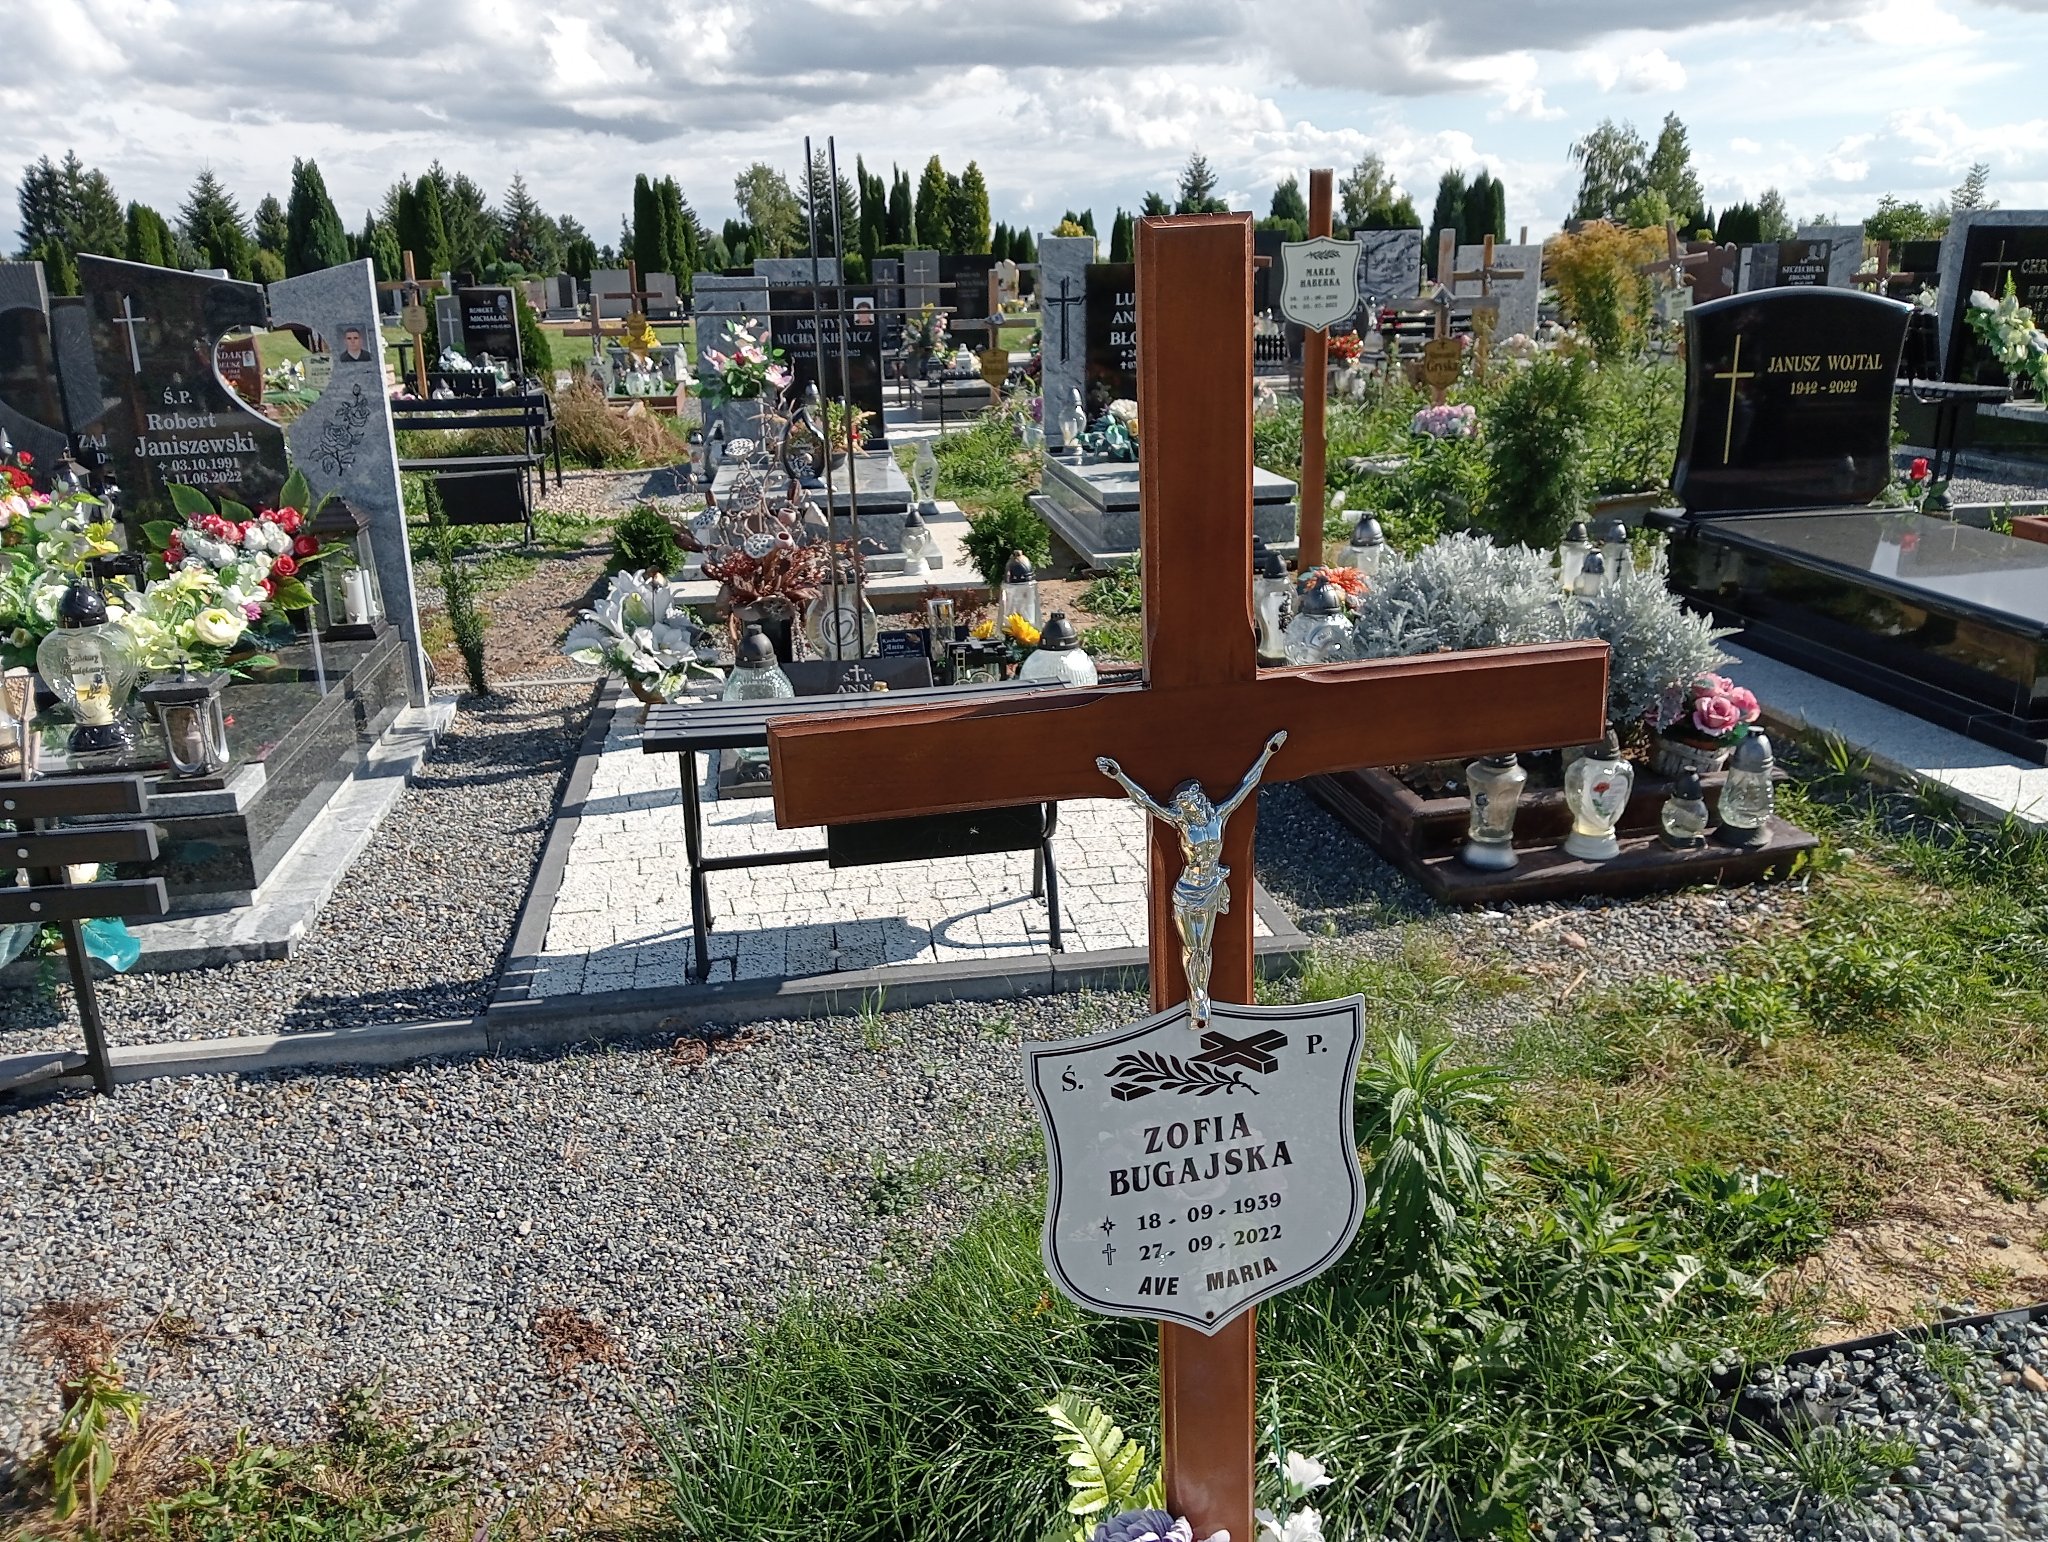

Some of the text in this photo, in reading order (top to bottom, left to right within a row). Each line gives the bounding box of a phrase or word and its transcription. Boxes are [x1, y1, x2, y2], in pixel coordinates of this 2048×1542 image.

[1306, 267, 1336, 277] MAREK
[1767, 353, 1883, 373] JANUSZ WOJTAL
[145, 412, 217, 431] Robert
[134, 431, 257, 458] Janiszewski
[171, 457, 240, 471] 03.10.1991
[174, 470, 243, 485] 11.06.2022
[1061, 1033, 1329, 1092] Ś. P.
[1142, 1111, 1252, 1155] ZOFIA
[1108, 1140, 1294, 1197] BUGAJSKA
[1137, 1256, 1279, 1296] AVE MARIA
